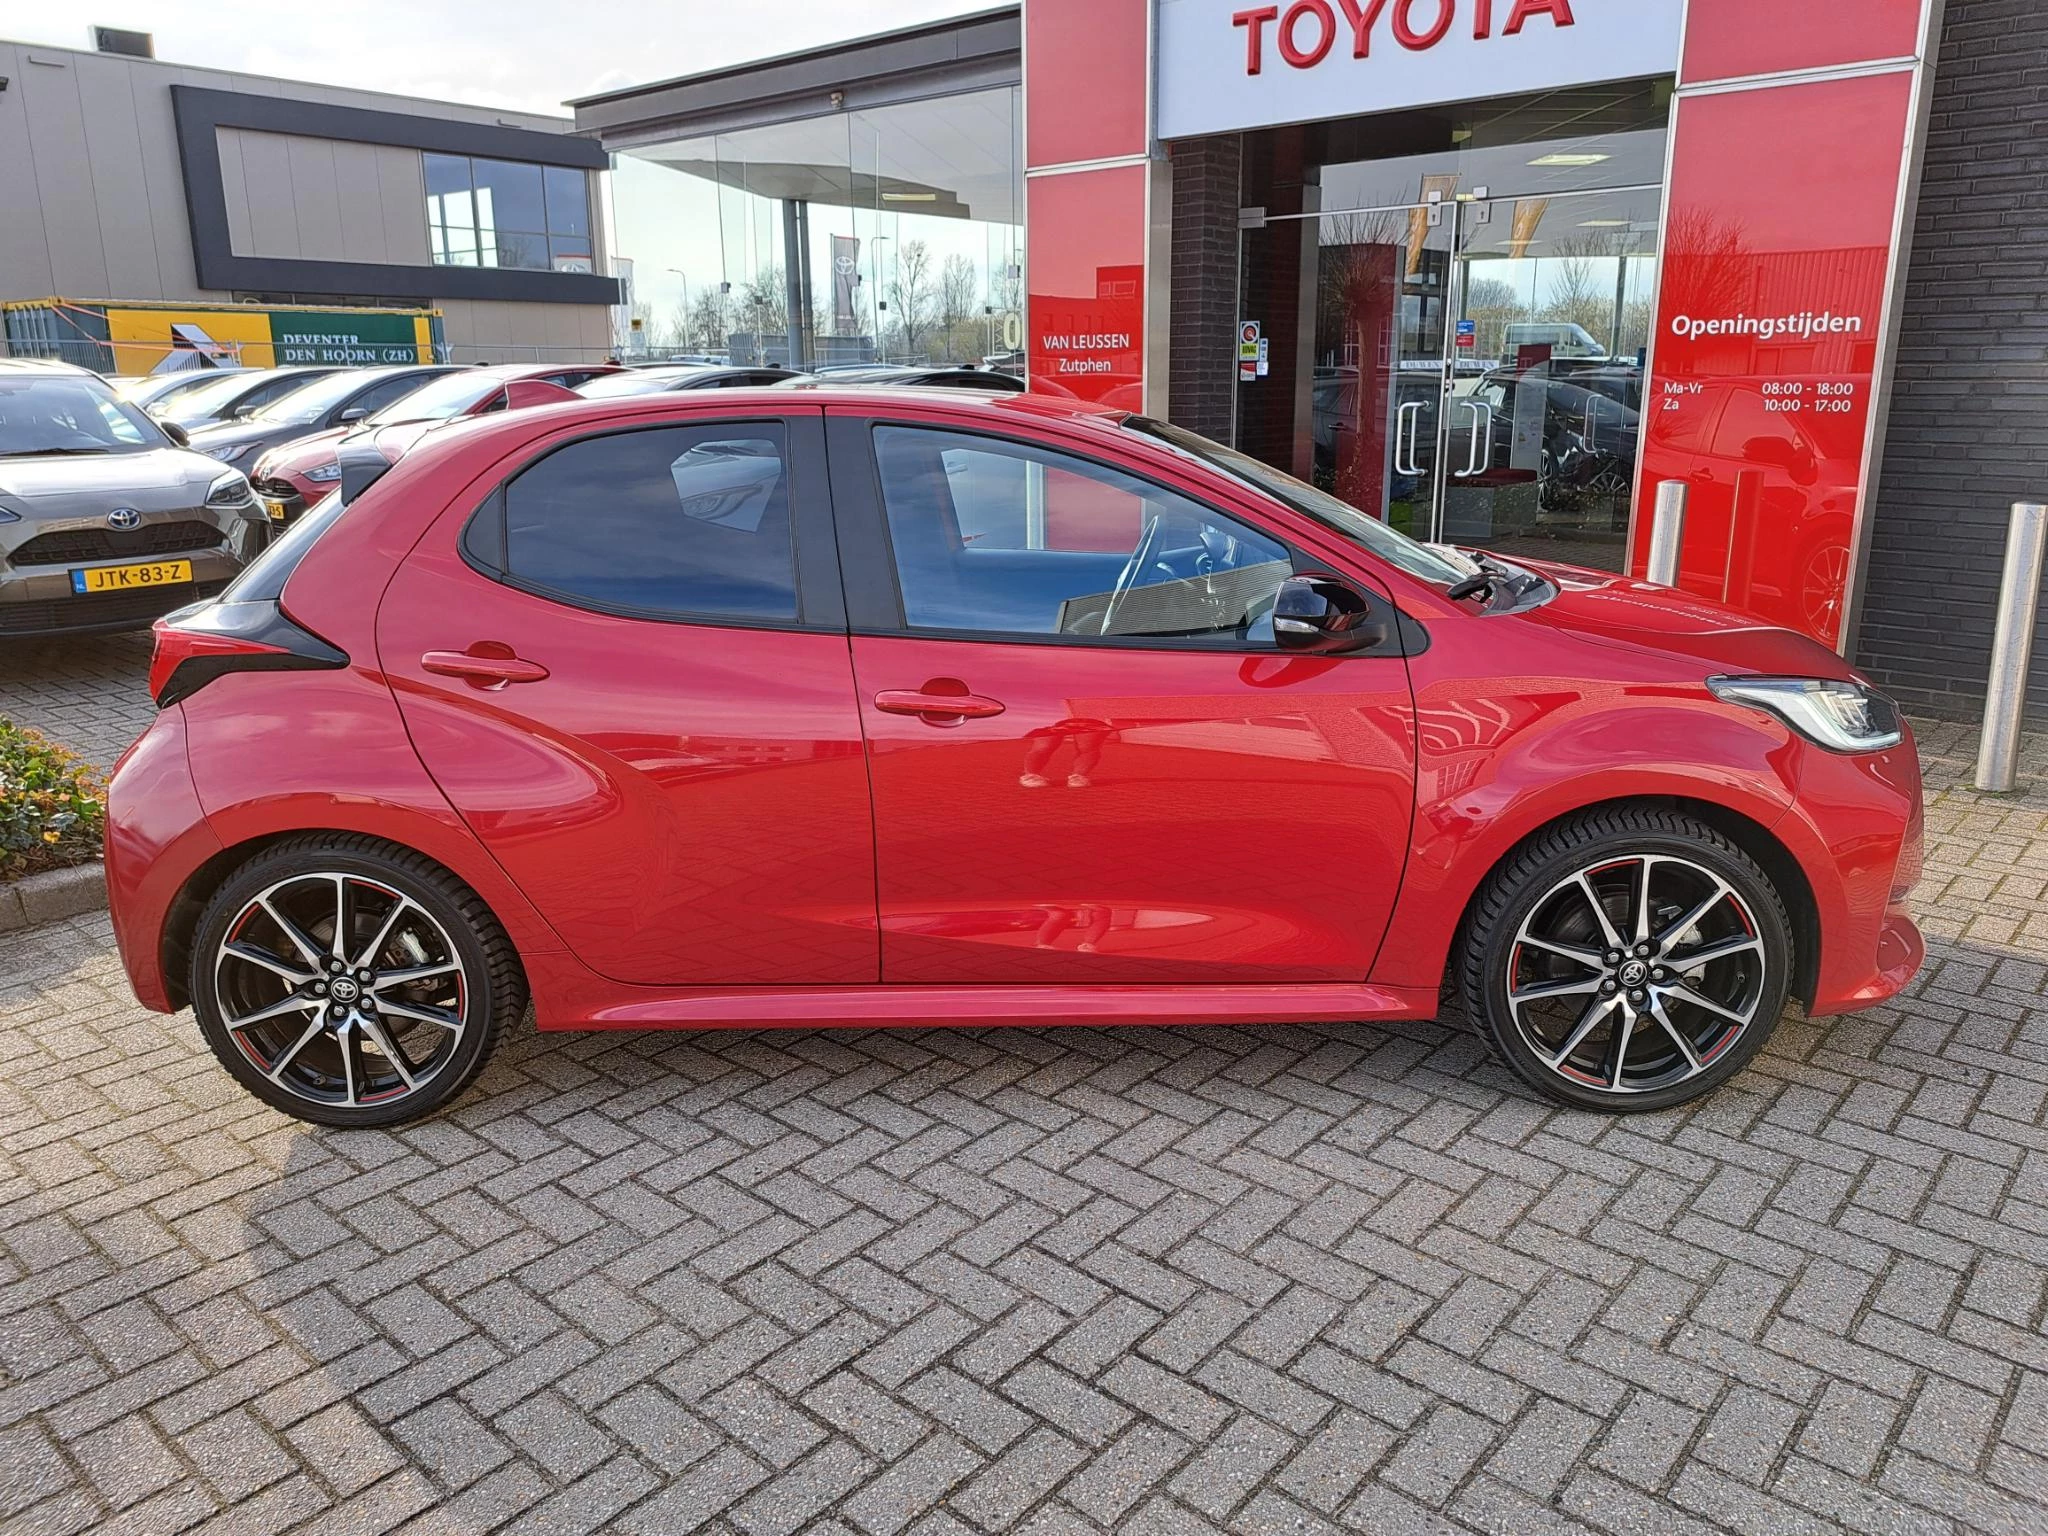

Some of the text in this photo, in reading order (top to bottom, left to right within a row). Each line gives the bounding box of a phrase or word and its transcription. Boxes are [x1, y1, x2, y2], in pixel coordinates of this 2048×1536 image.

[1671, 311, 1861, 341] Openingstijden
[283, 333, 359, 345] DEVENTER
[1043, 333, 1130, 350] VAN LEUSSEN
[286, 348, 414, 363] DEN HOORN (ZH)
[1059, 357, 1111, 375] Zutphen
[1664, 382, 1703, 395] Ma-Vr
[1762, 382, 1802, 395] 08:00
[1816, 382, 1853, 396] 18:00
[1663, 398, 1679, 411] Za
[1764, 399, 1801, 412] 10:00
[1815, 399, 1851, 413] 17:00
[95, 564, 182, 588] JTK-83-Z
